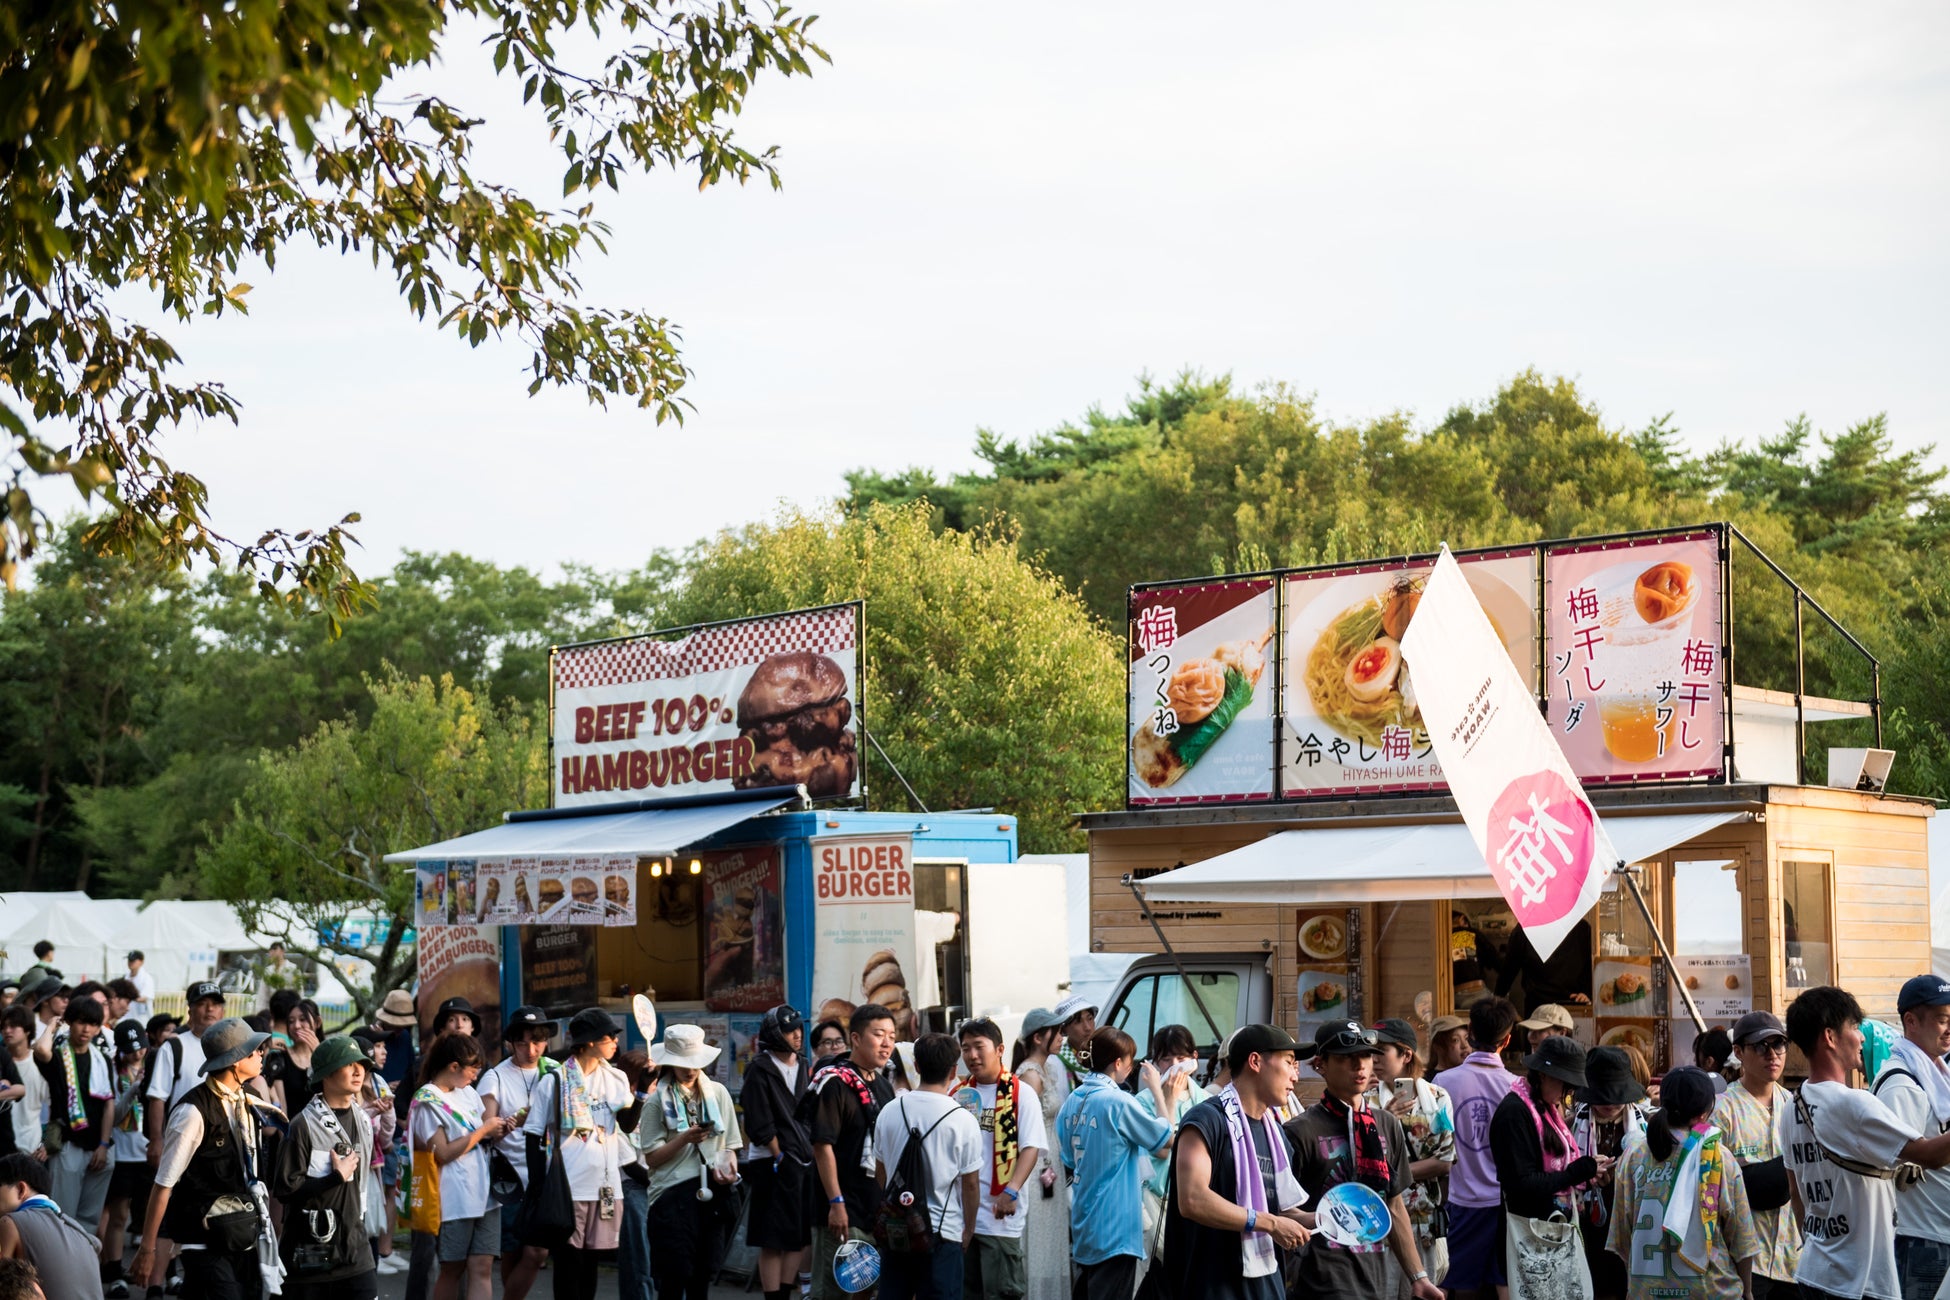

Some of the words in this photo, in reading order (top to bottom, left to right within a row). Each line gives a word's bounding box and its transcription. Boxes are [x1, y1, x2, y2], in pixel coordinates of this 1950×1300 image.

[1566, 586, 1607, 693] 梅干し
[1139, 608, 1178, 735] 梅つくね
[1555, 649, 1586, 734] ソーダ
[1678, 638, 1715, 751] 梅干し
[574, 700, 646, 744] BEEF
[652, 694, 734, 737] 100%
[1656, 680, 1677, 758] サワー
[561, 736, 756, 795] HAMBURGER
[1343, 767, 1393, 781] HIYASHI
[1396, 766, 1425, 778] UME
[705, 851, 746, 886] SLIDER
[822, 845, 905, 873] SLIDER
[817, 871, 912, 899] BURGER
[419, 935, 447, 967] BEEF
[448, 926, 478, 942] 100%
[419, 939, 496, 985] HAMBURGERS
[536, 932, 579, 949] BURGER
[1470, 1102, 1490, 1144] 塩川
